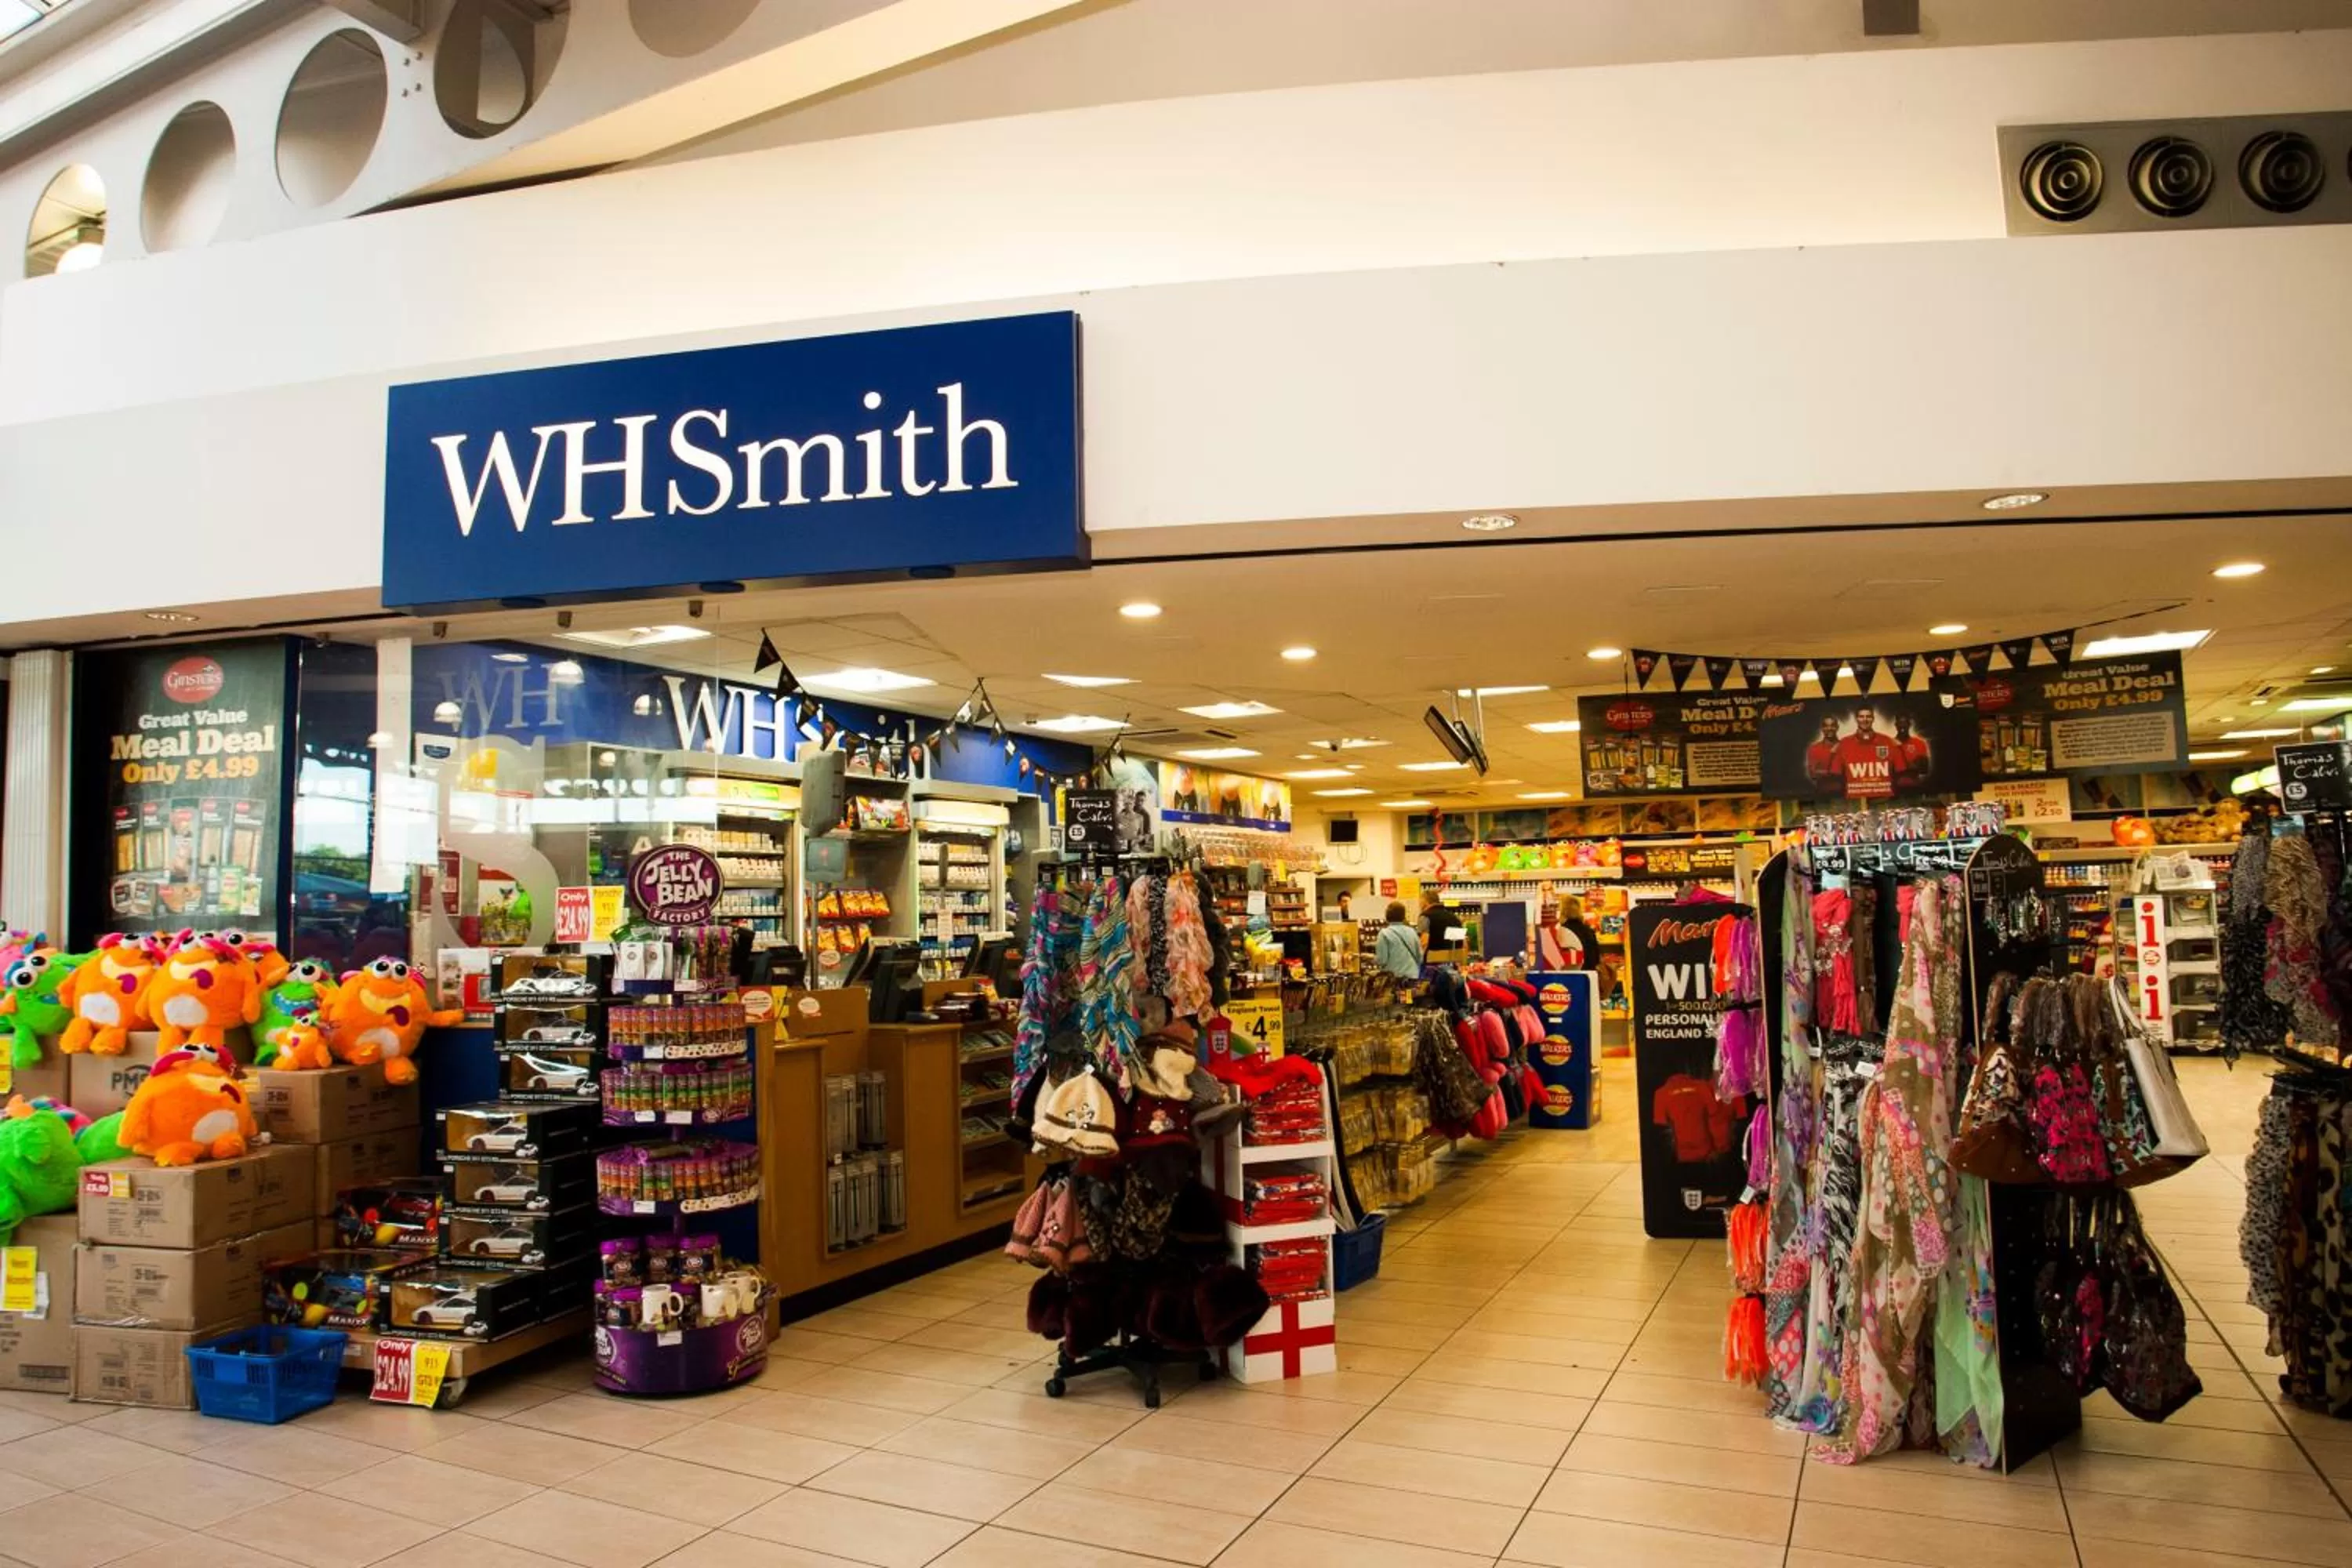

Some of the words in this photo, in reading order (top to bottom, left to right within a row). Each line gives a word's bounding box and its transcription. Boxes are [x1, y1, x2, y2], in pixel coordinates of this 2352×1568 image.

[431, 382, 1018, 536] WHSmith
[2107, 664, 2149, 674] Value
[2042, 678, 2107, 699] Meal
[2113, 671, 2176, 691] Deal
[2054, 696, 2101, 711] Only
[2105, 689, 2164, 706] £4.99
[139, 712, 191, 730] Great
[193, 709, 248, 725] Value
[1681, 708, 1734, 721] Meal
[1689, 723, 1729, 734] Only
[111, 730, 191, 760] Meal
[197, 725, 275, 755] Deal
[122, 762, 181, 784] Only
[185, 756, 260, 780] £4.99
[1849, 761, 1889, 779] WIN
[2280, 753, 2334, 766] Thomas
[667, 851, 691, 862] THE
[644, 858, 704, 886] JELLY
[561, 891, 587, 902] Only
[655, 877, 713, 907] BEAN
[557, 905, 590, 935] £24.99
[652, 906, 706, 924] FACTORY
[2140, 902, 2160, 947] i
[1647, 918, 1719, 949] Mar
[1539, 992, 1572, 1003] WALKERS
[2145, 975, 2163, 1022] i
[1646, 1028, 1702, 1040] ENGLAND
[379, 1339, 410, 1354] Only
[376, 1355, 410, 1393] £24.99
